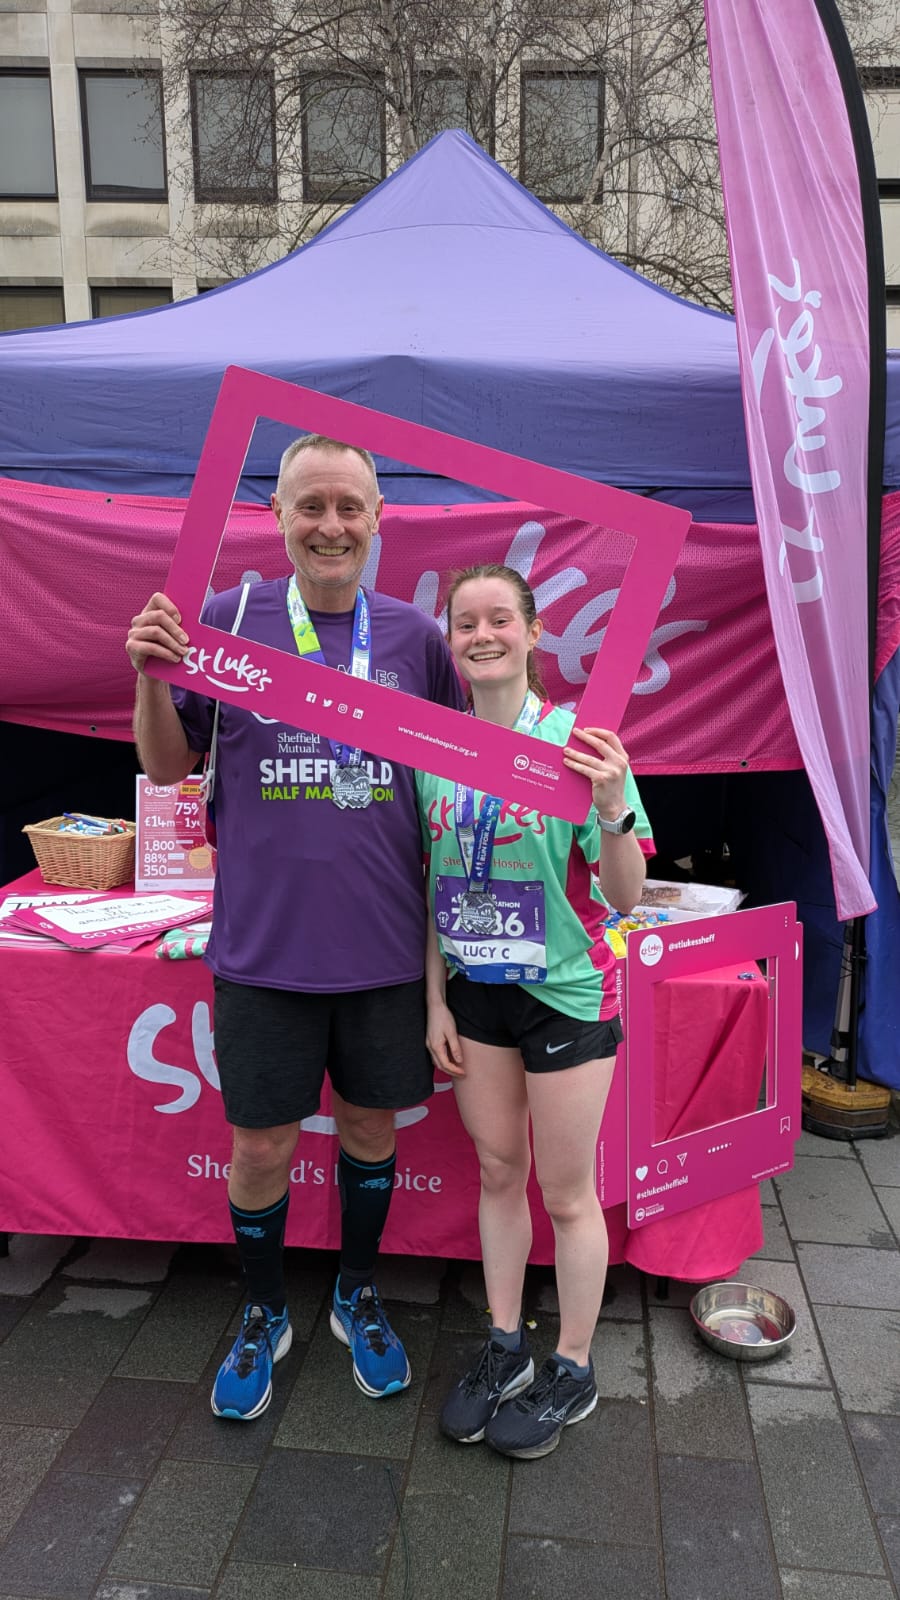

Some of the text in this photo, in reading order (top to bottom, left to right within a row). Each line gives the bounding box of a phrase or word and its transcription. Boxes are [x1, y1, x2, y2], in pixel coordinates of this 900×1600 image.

[182, 646, 273, 692] St Luke's
[277, 732, 320, 744] Sheffield
[278, 743, 315, 754] Mutual
[261, 786, 300, 801] HALF
[144, 840, 175, 853] 1,800
[144, 852, 167, 864] 88%
[492, 857, 534, 871] Hospice
[143, 864, 167, 876] 350
[109, 923, 152, 935] TEAM
[668, 934, 715, 952] @stlukessheff
[463, 944, 511, 960] LUCY C
